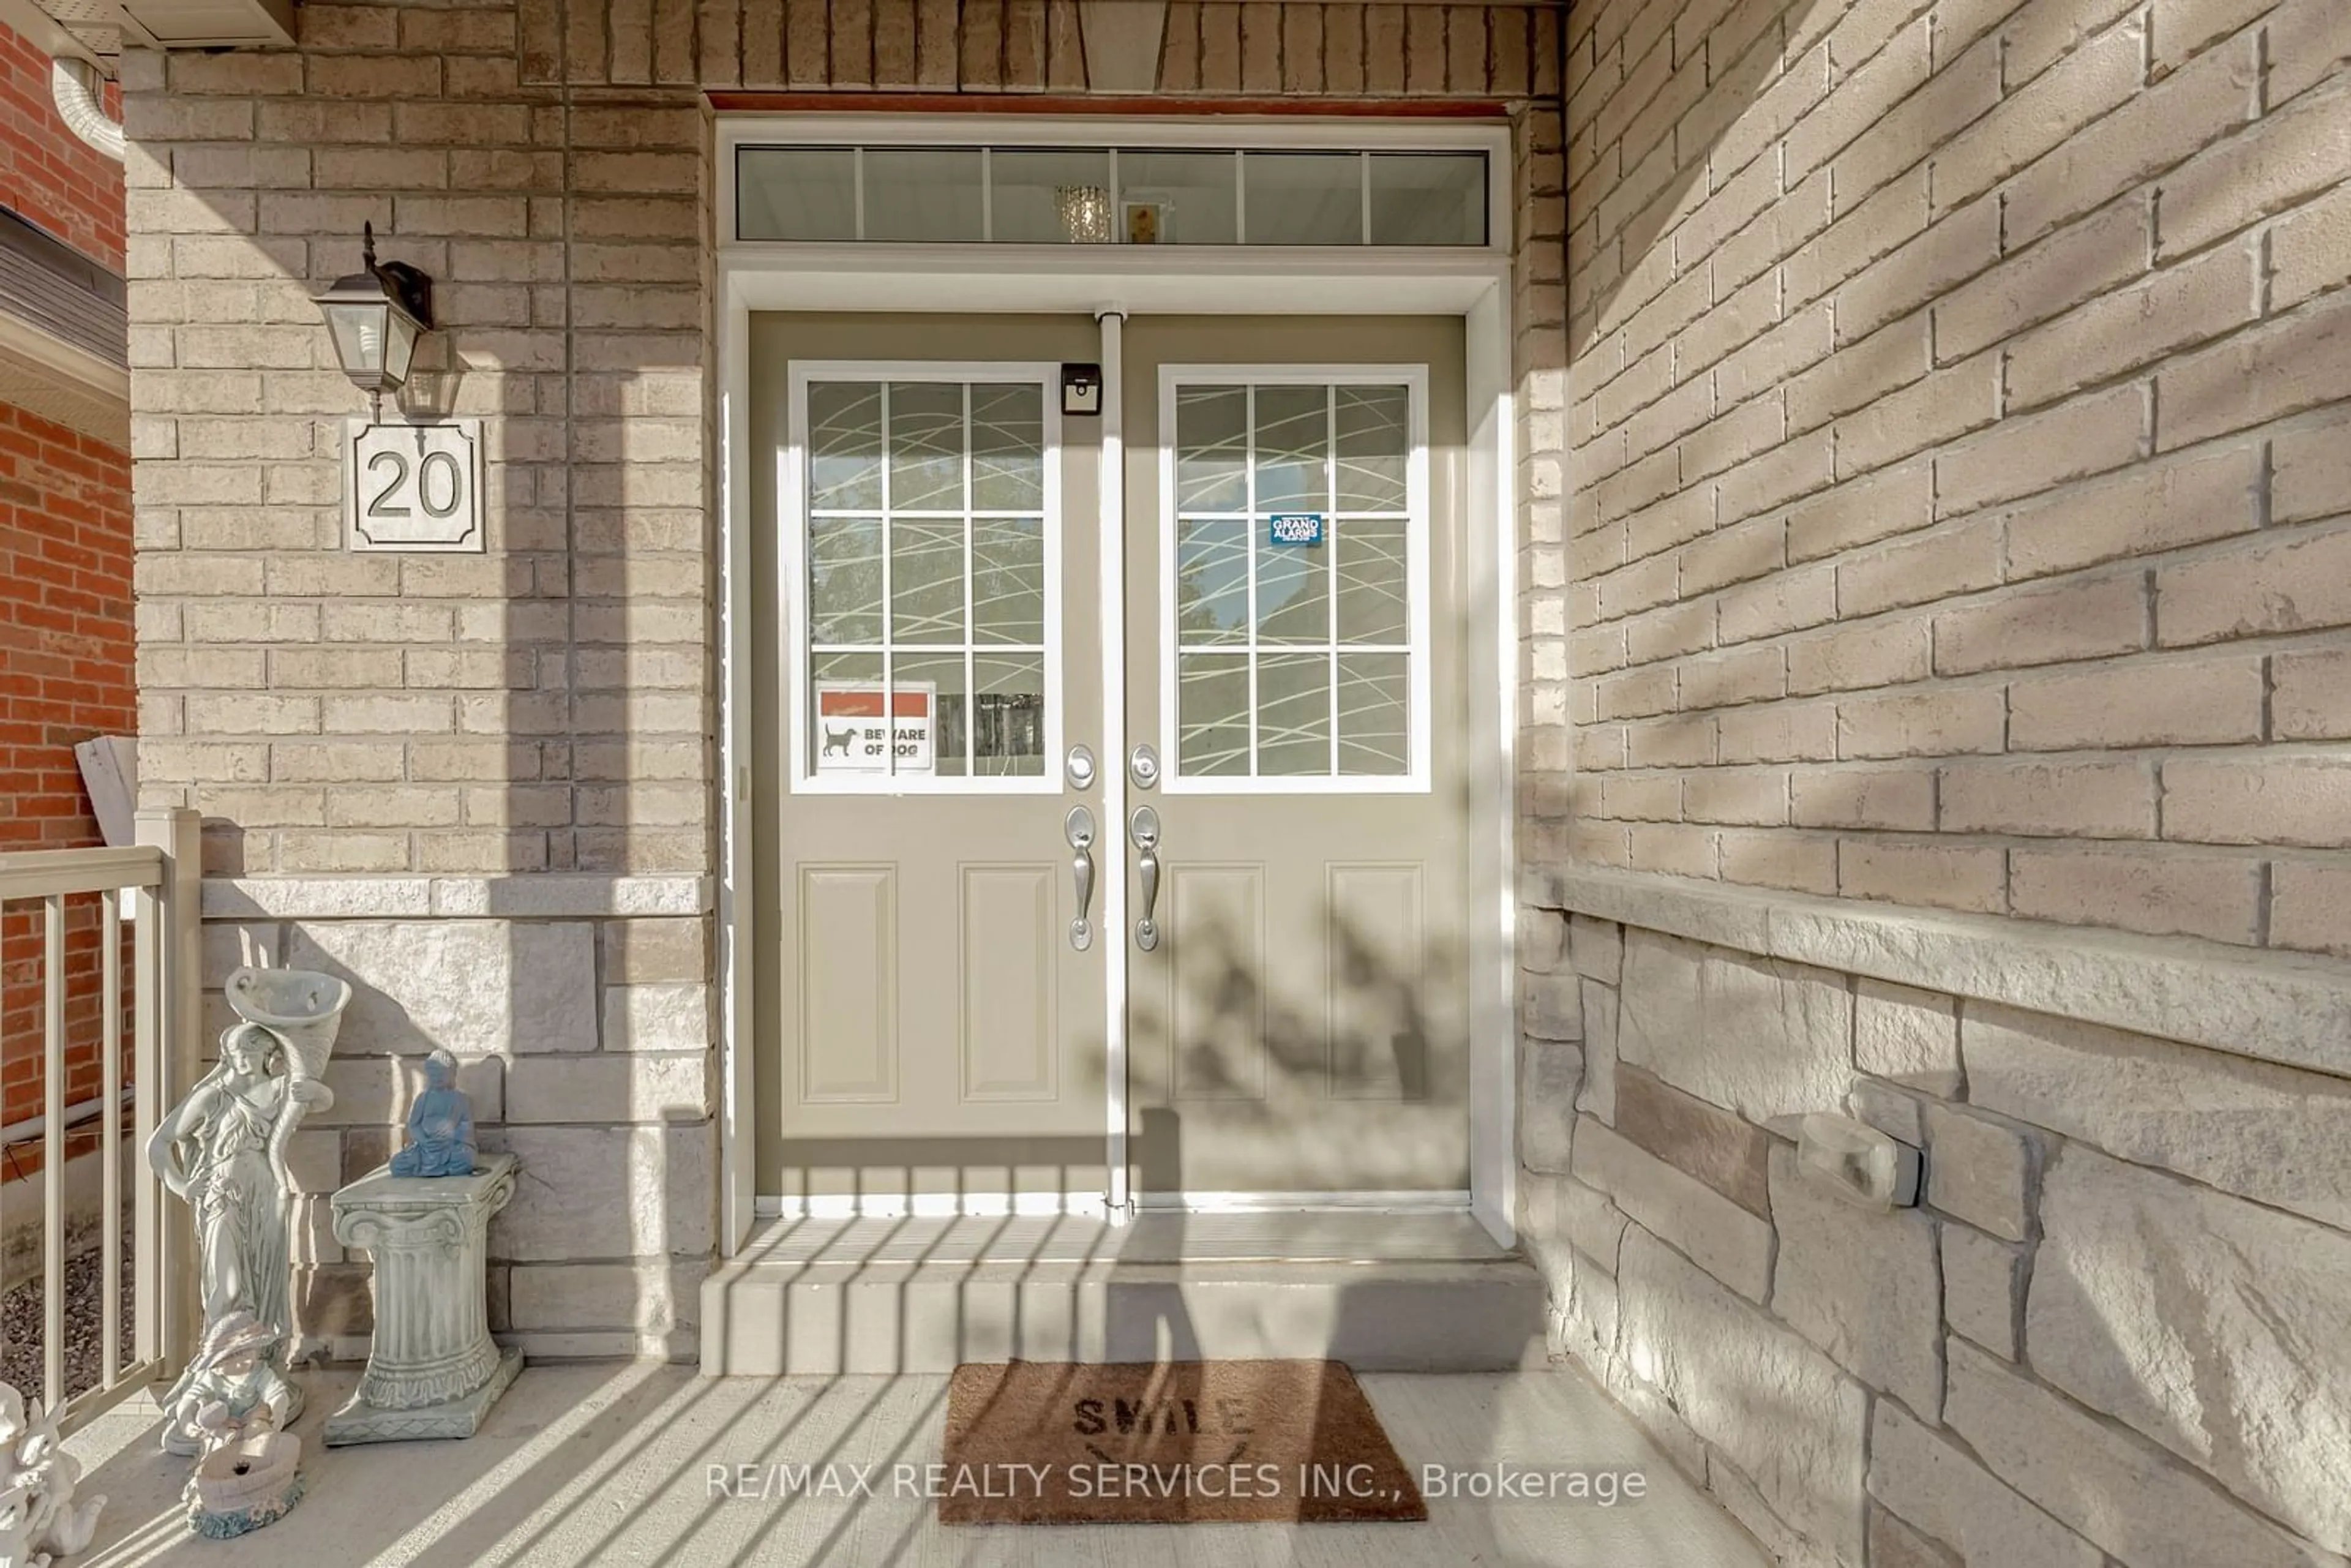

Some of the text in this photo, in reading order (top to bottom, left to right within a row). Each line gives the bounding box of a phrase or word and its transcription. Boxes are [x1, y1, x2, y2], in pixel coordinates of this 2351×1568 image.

[367, 451, 462, 519] 20
[1273, 519, 1319, 529] GRAND
[864, 745, 884, 756] OF
